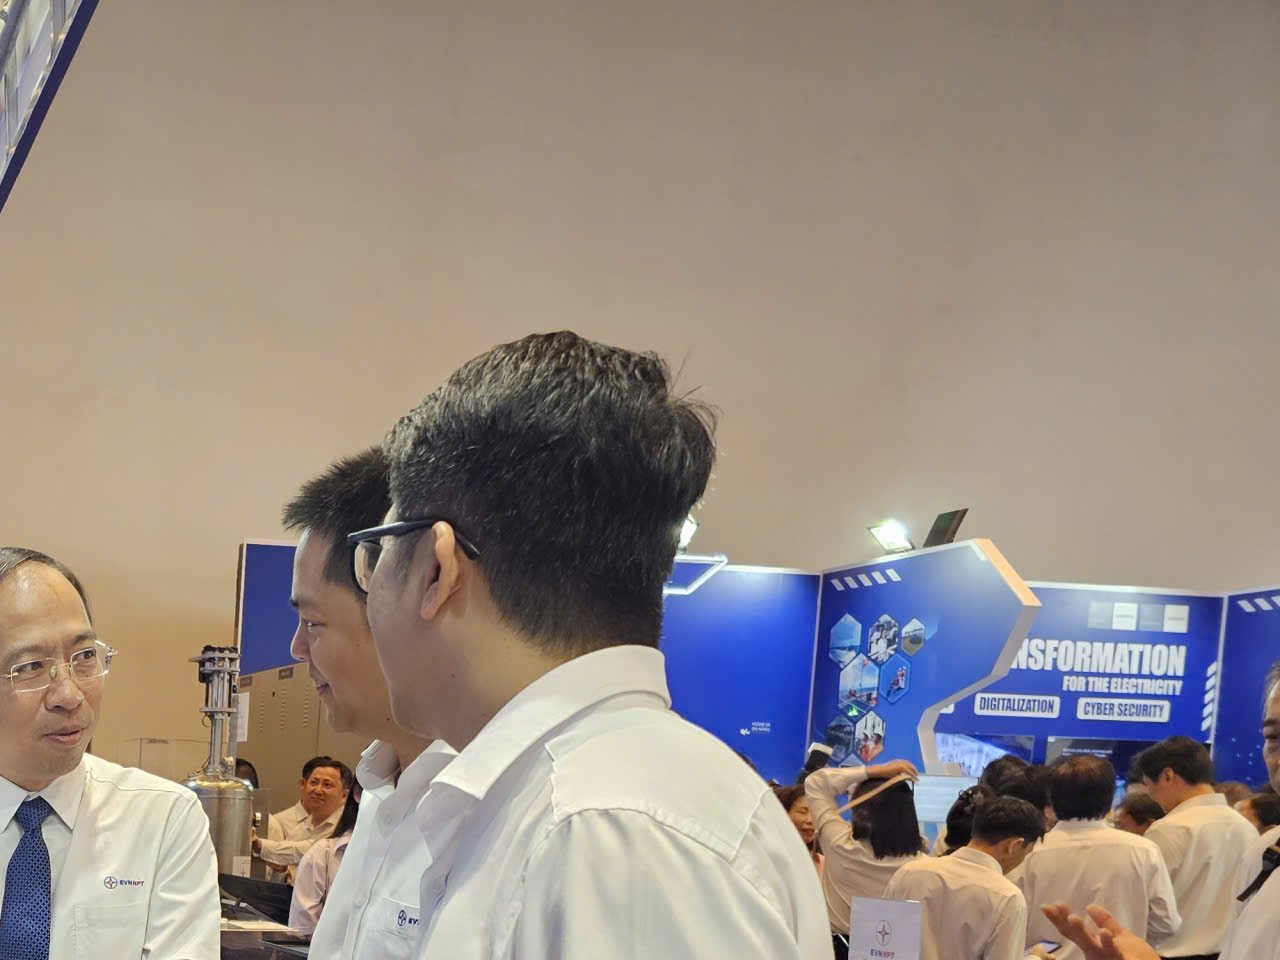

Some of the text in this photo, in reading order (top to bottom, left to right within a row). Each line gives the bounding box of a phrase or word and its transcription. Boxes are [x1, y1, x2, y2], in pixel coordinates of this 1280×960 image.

[1062, 675, 1184, 696] FOR THE ELECTRICITY
[979, 696, 1055, 713] DIGITALIZATION
[1083, 702, 1164, 718] CYBER SECURITY
[870, 948, 895, 959] EVNNPT
